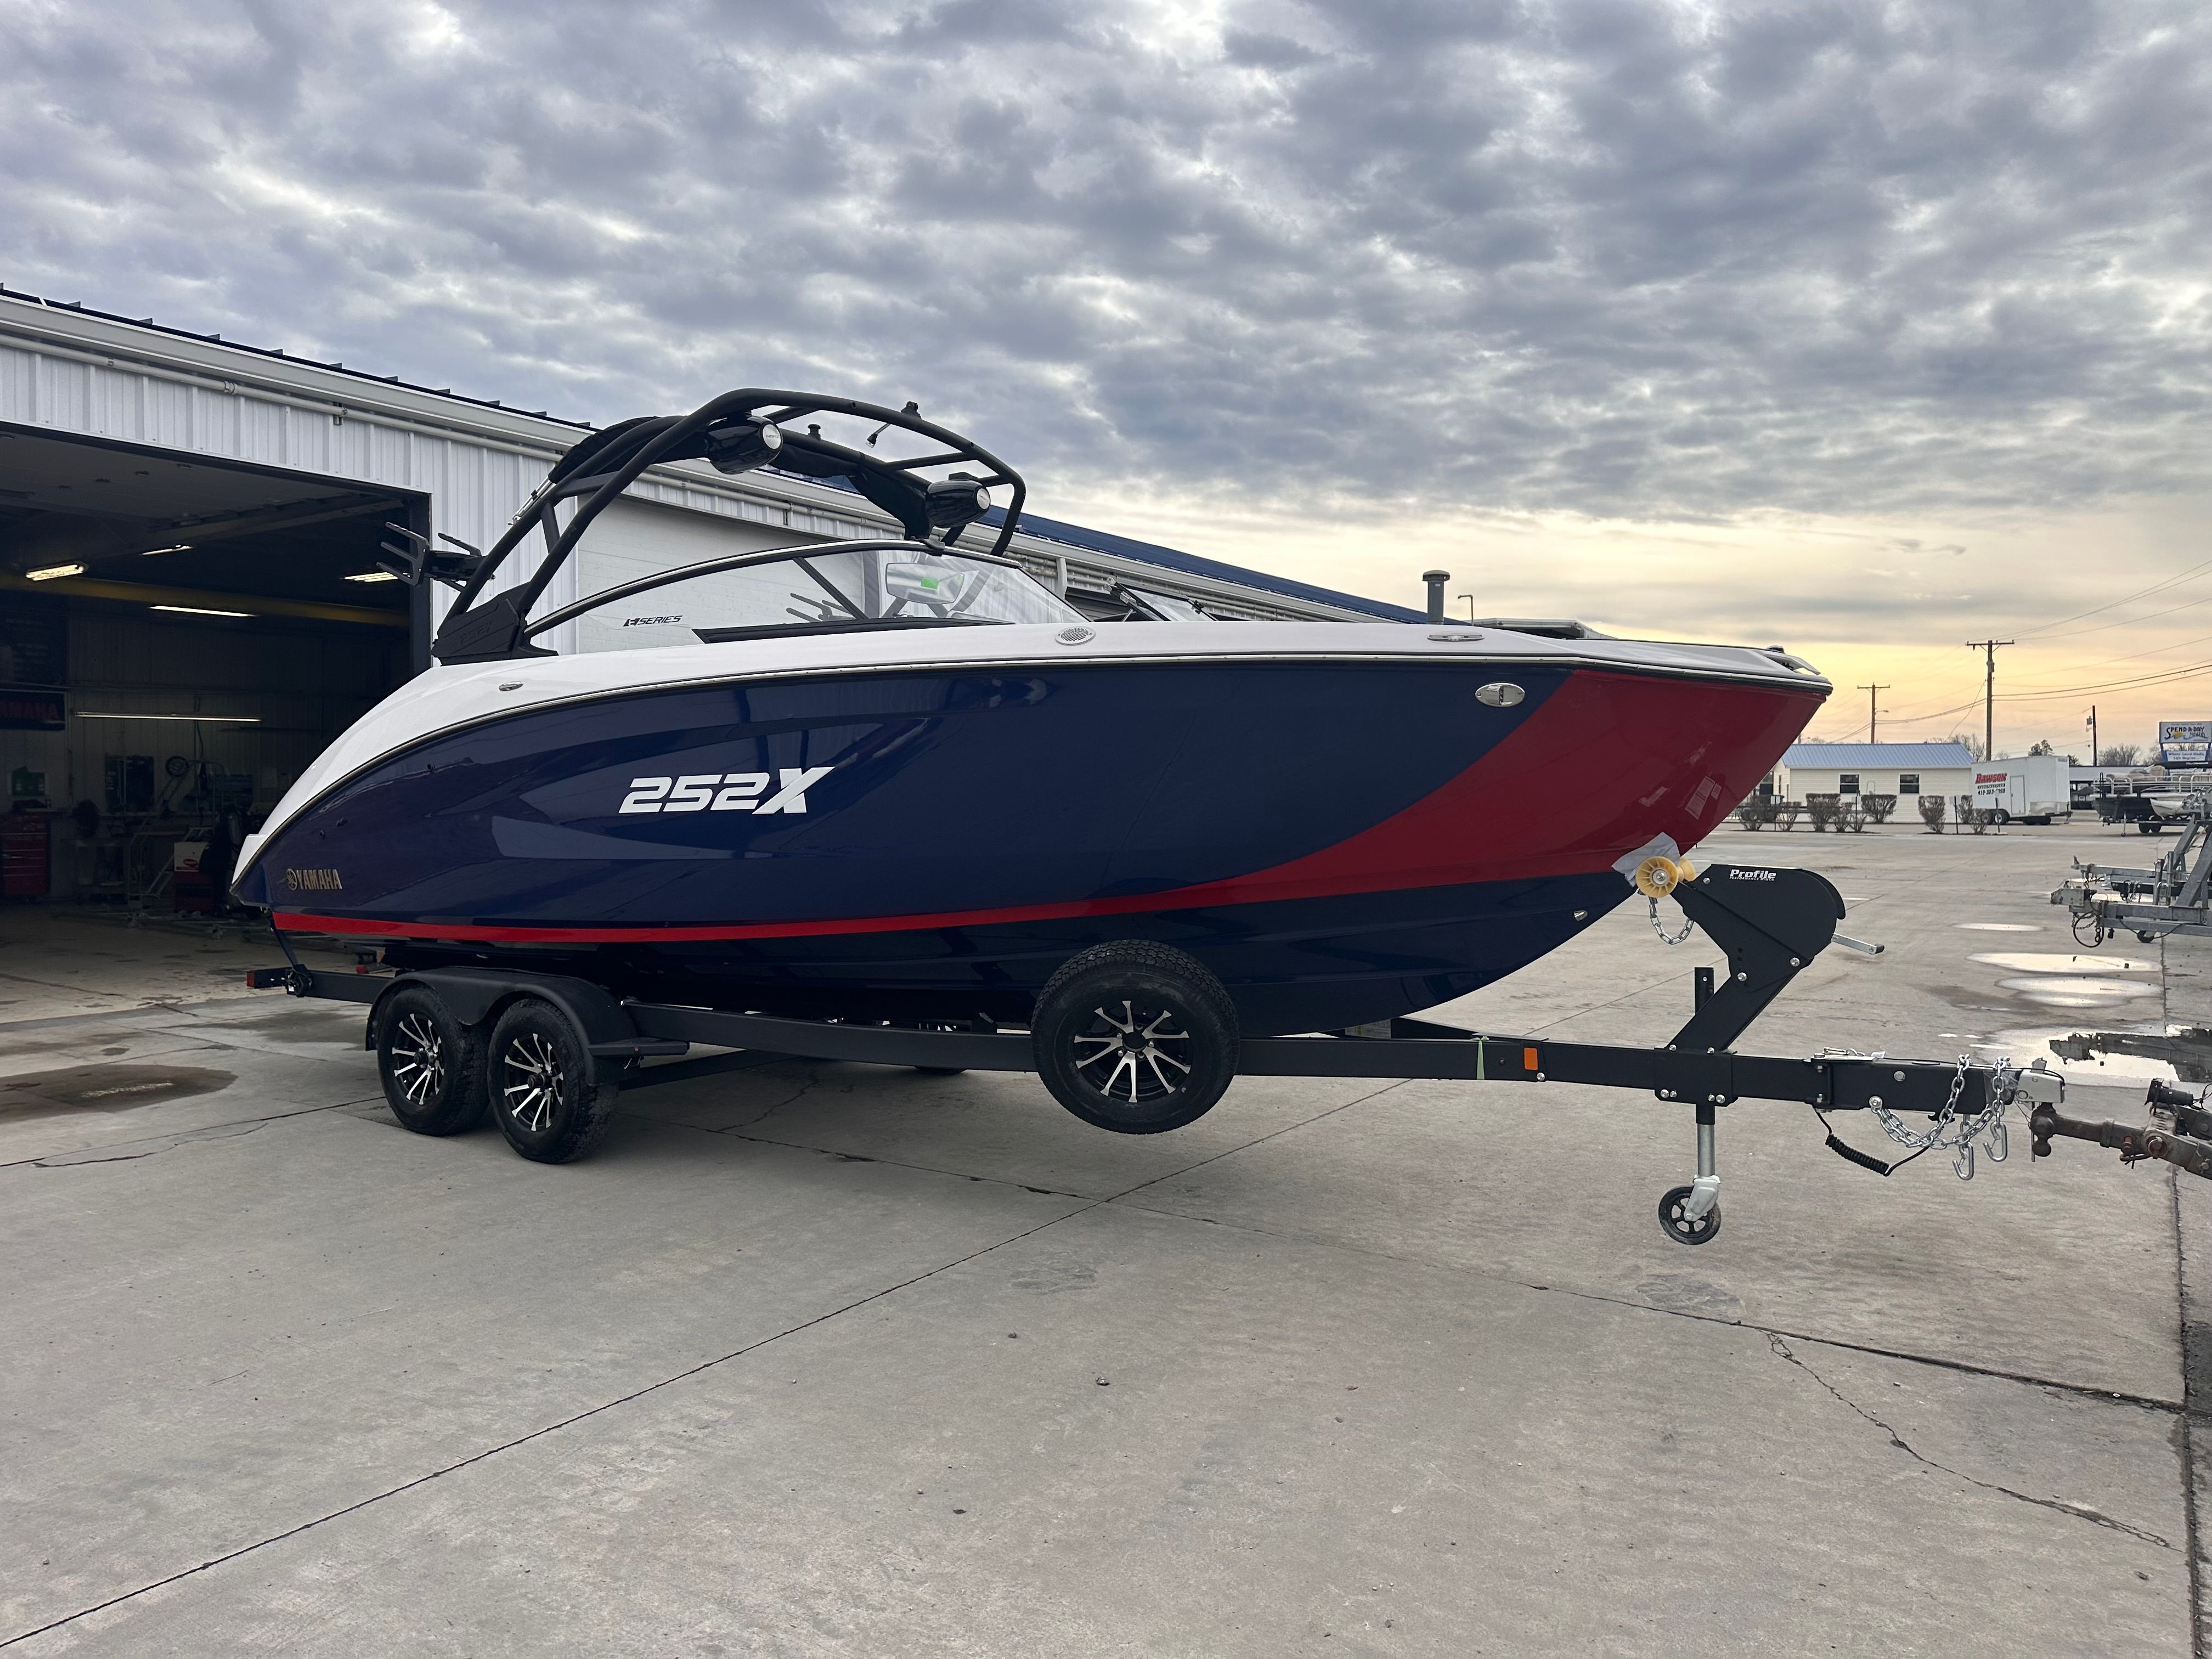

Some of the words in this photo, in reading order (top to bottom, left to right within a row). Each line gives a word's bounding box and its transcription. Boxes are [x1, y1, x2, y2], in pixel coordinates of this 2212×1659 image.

[1976, 773, 2007, 784] DAWSON
[618, 766, 836, 815] 252X
[296, 869, 343, 889] YAMAHA
[1730, 869, 1776, 878] Profile
